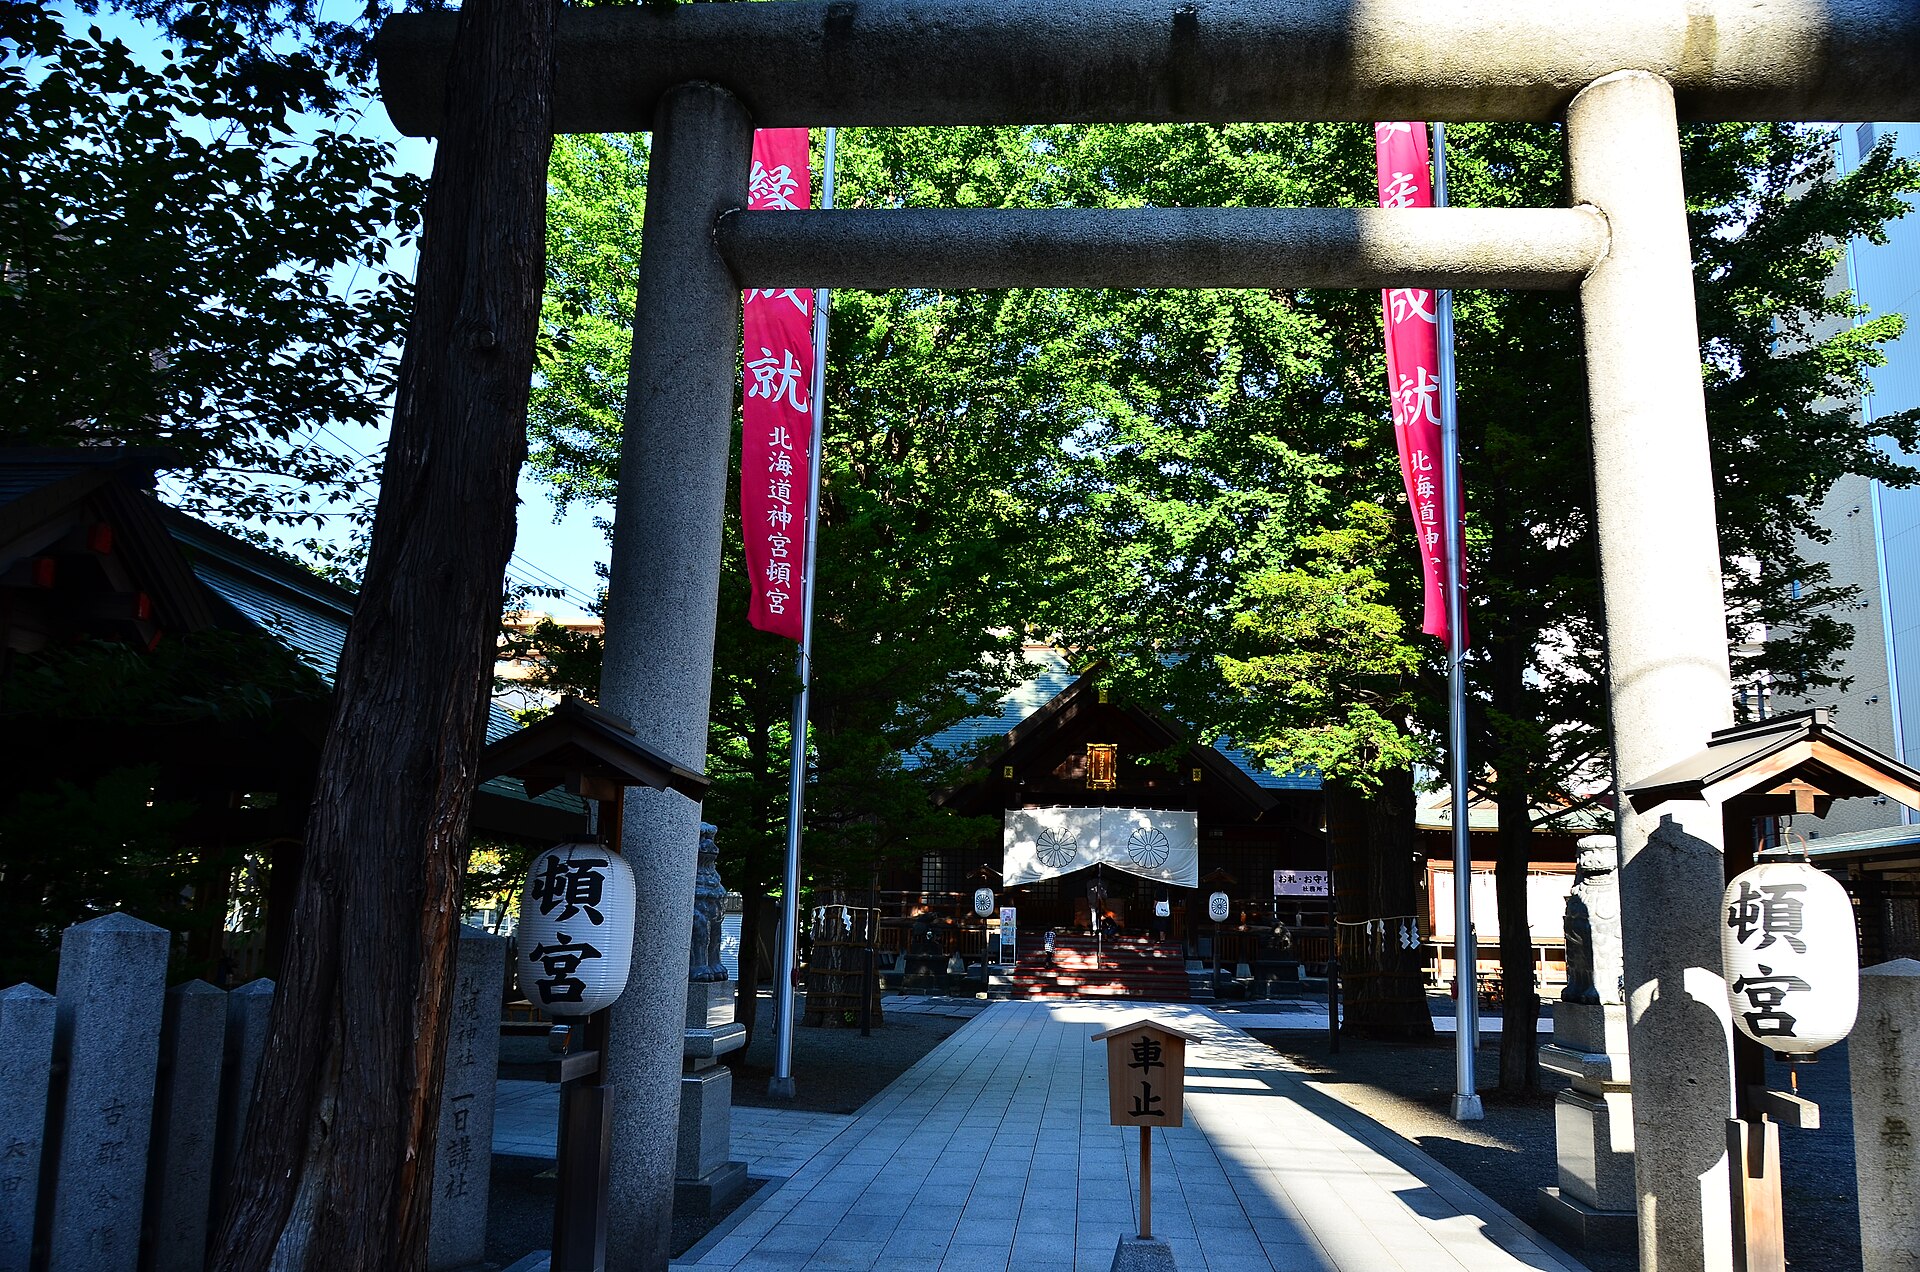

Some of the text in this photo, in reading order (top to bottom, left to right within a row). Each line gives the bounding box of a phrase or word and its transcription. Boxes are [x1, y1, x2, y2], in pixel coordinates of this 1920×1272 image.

[765, 425, 793, 615] 北海道神宮頓宮
[529, 854, 609, 1005] 頓宮
[1727, 881, 1812, 1038] 頓宮
[1128, 1036, 1165, 1118] 車止
